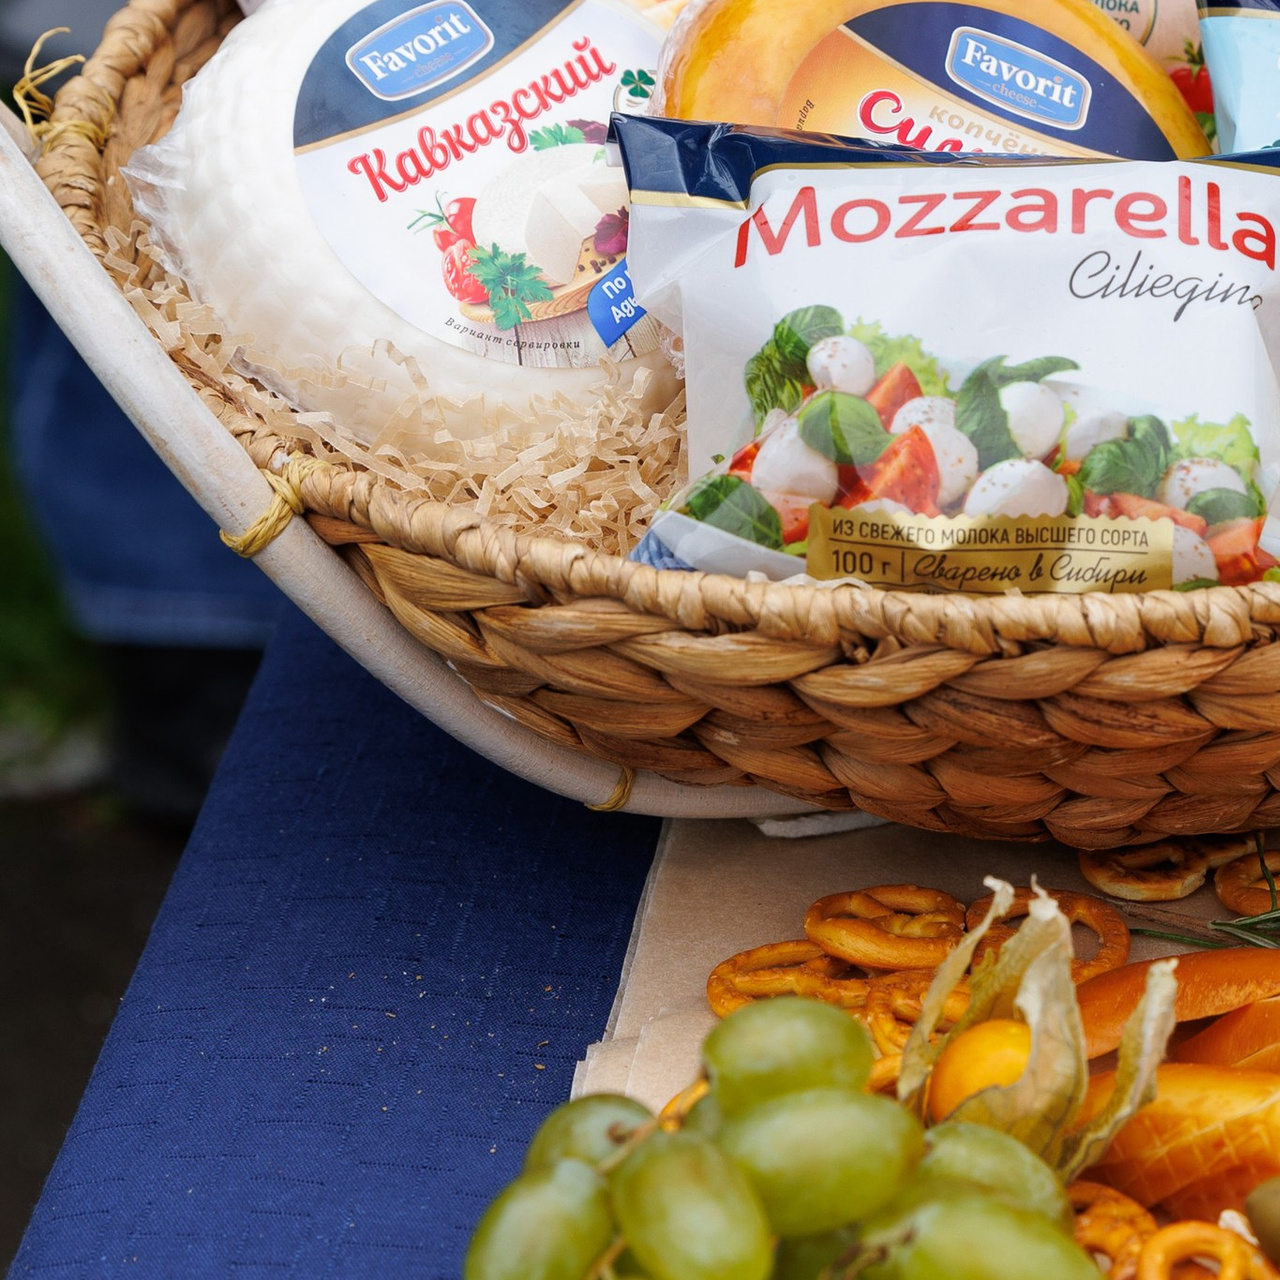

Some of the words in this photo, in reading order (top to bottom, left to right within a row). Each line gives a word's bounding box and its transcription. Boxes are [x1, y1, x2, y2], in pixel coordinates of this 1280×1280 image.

[359, 11, 472, 82] Favorit
[412, 51, 455, 79] cheese
[960, 36, 1076, 110] Favorit
[991, 80, 1039, 110] cheese
[347, 35, 617, 204] Кавказский
[733, 175, 1278, 271] Mozzarella
[444, 317, 503, 345] Вариант
[505, 338, 582, 351] сервировки
[832, 518, 854, 537] ИЗ
[859, 521, 936, 544] СВЕЖЕГО
[940, 523, 1011, 545] МОЛОКА
[1015, 524, 1097, 546] ВЫСШЕГО
[1100, 527, 1150, 548] СОРТА
[831, 549, 874, 576] 100
[881, 559, 892, 576] г
[912, 552, 1022, 591] Сварено
[1028, 551, 1045, 579] в
[1049, 553, 1149, 593] Сибири
